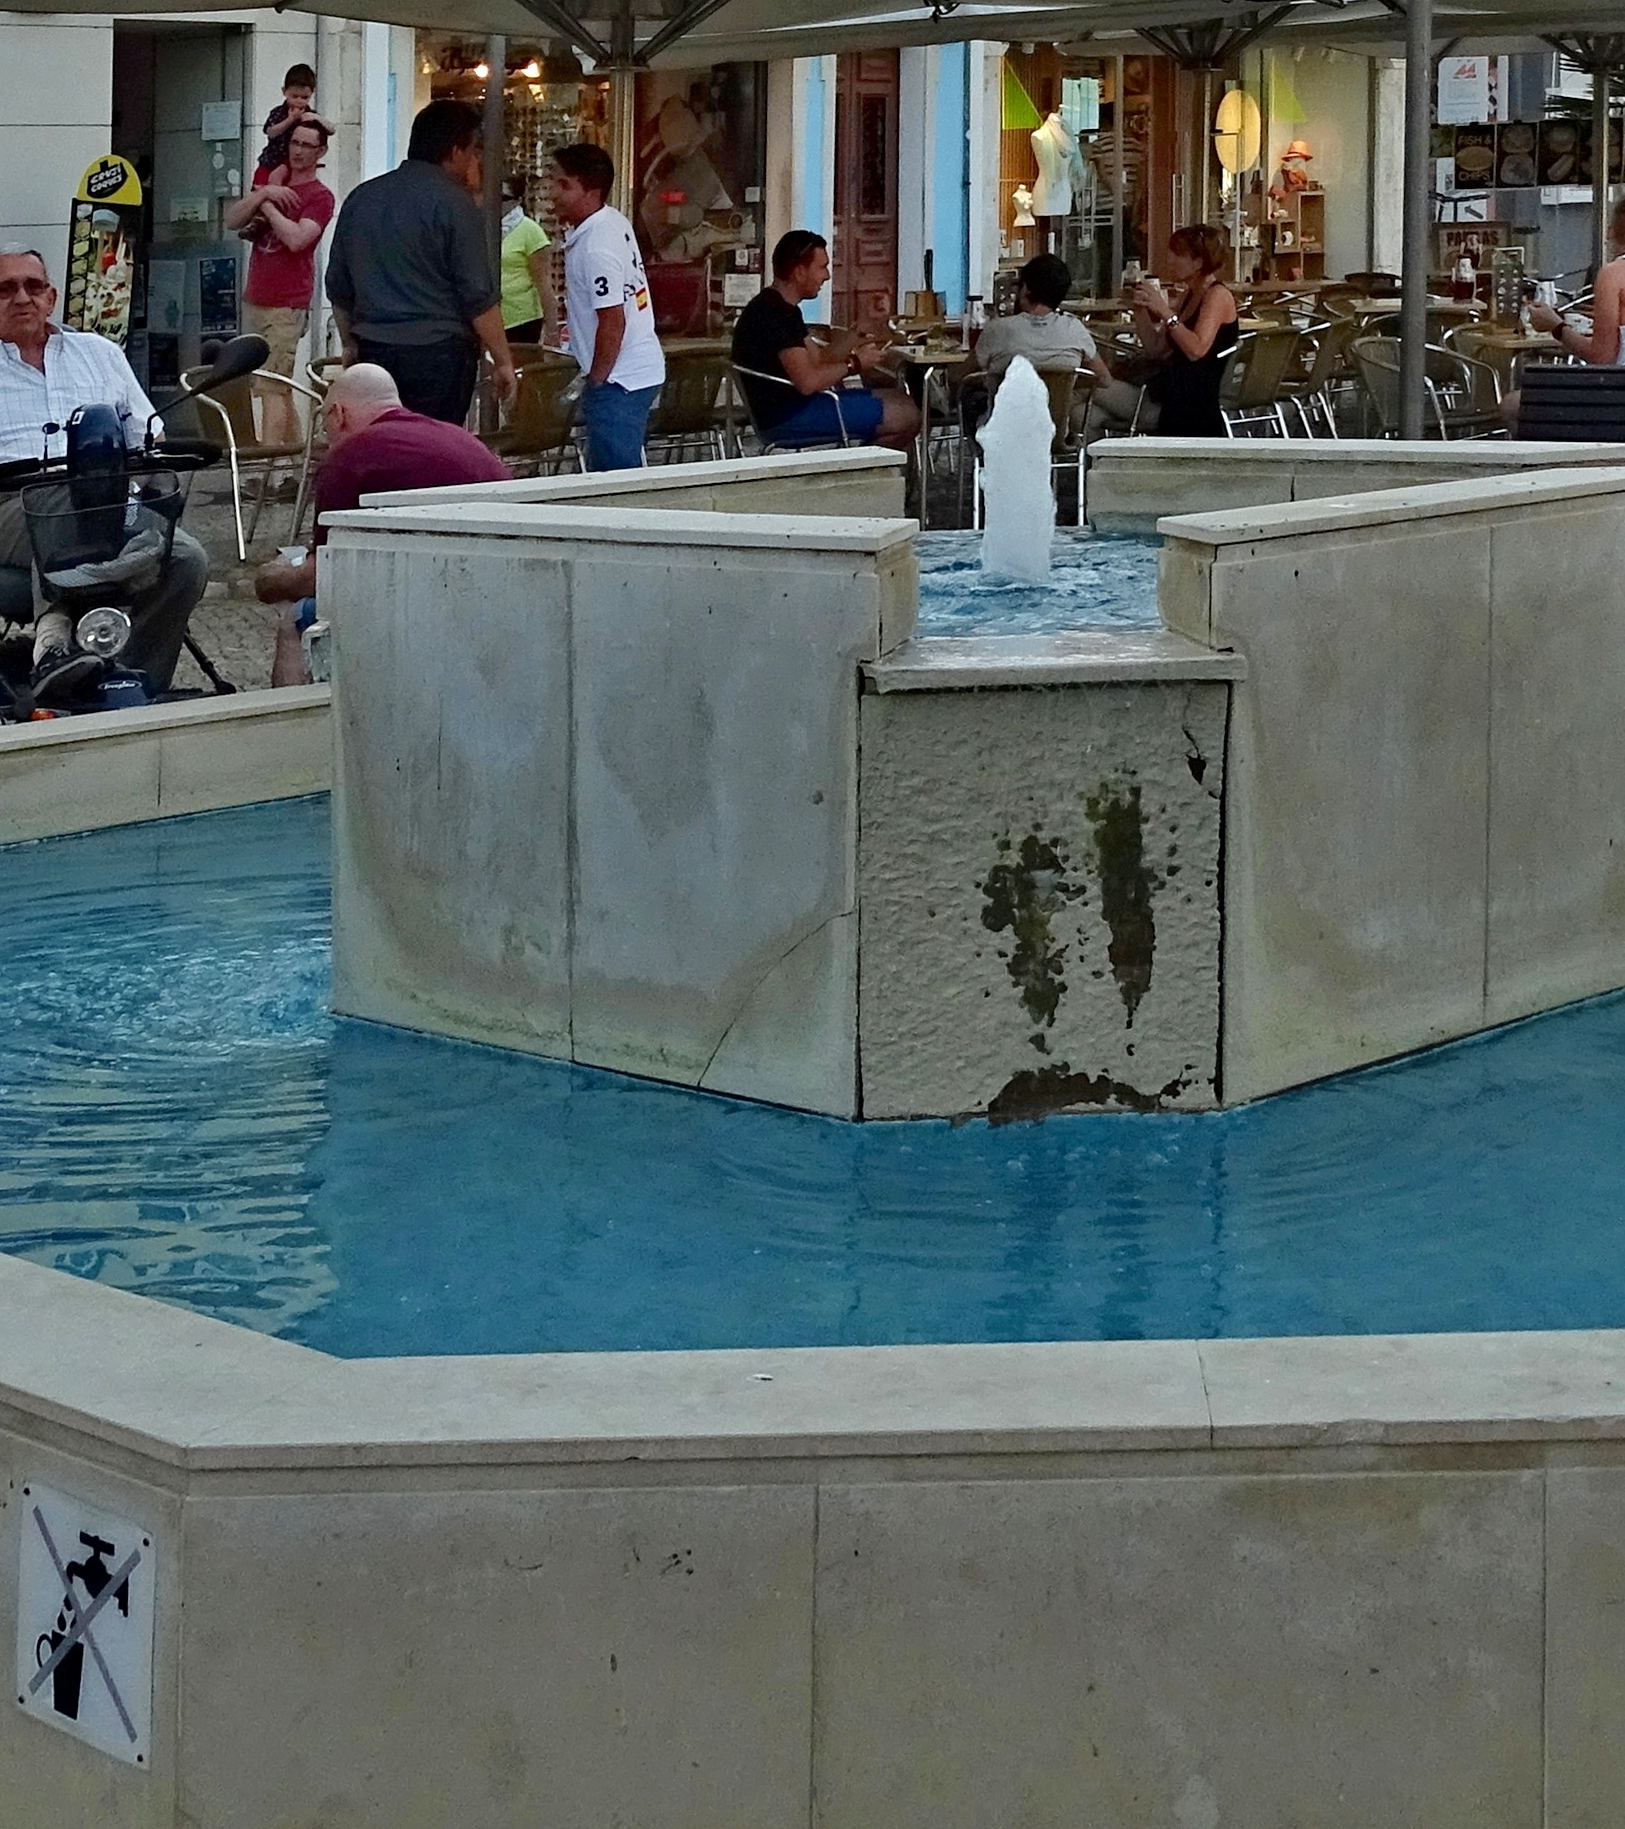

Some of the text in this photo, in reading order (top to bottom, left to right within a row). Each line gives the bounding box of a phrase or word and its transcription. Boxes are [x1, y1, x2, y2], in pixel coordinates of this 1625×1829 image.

[1458, 135, 1482, 145] FISH
[1459, 172, 1490, 181] CHIPS
[594, 276, 609, 296] 3
